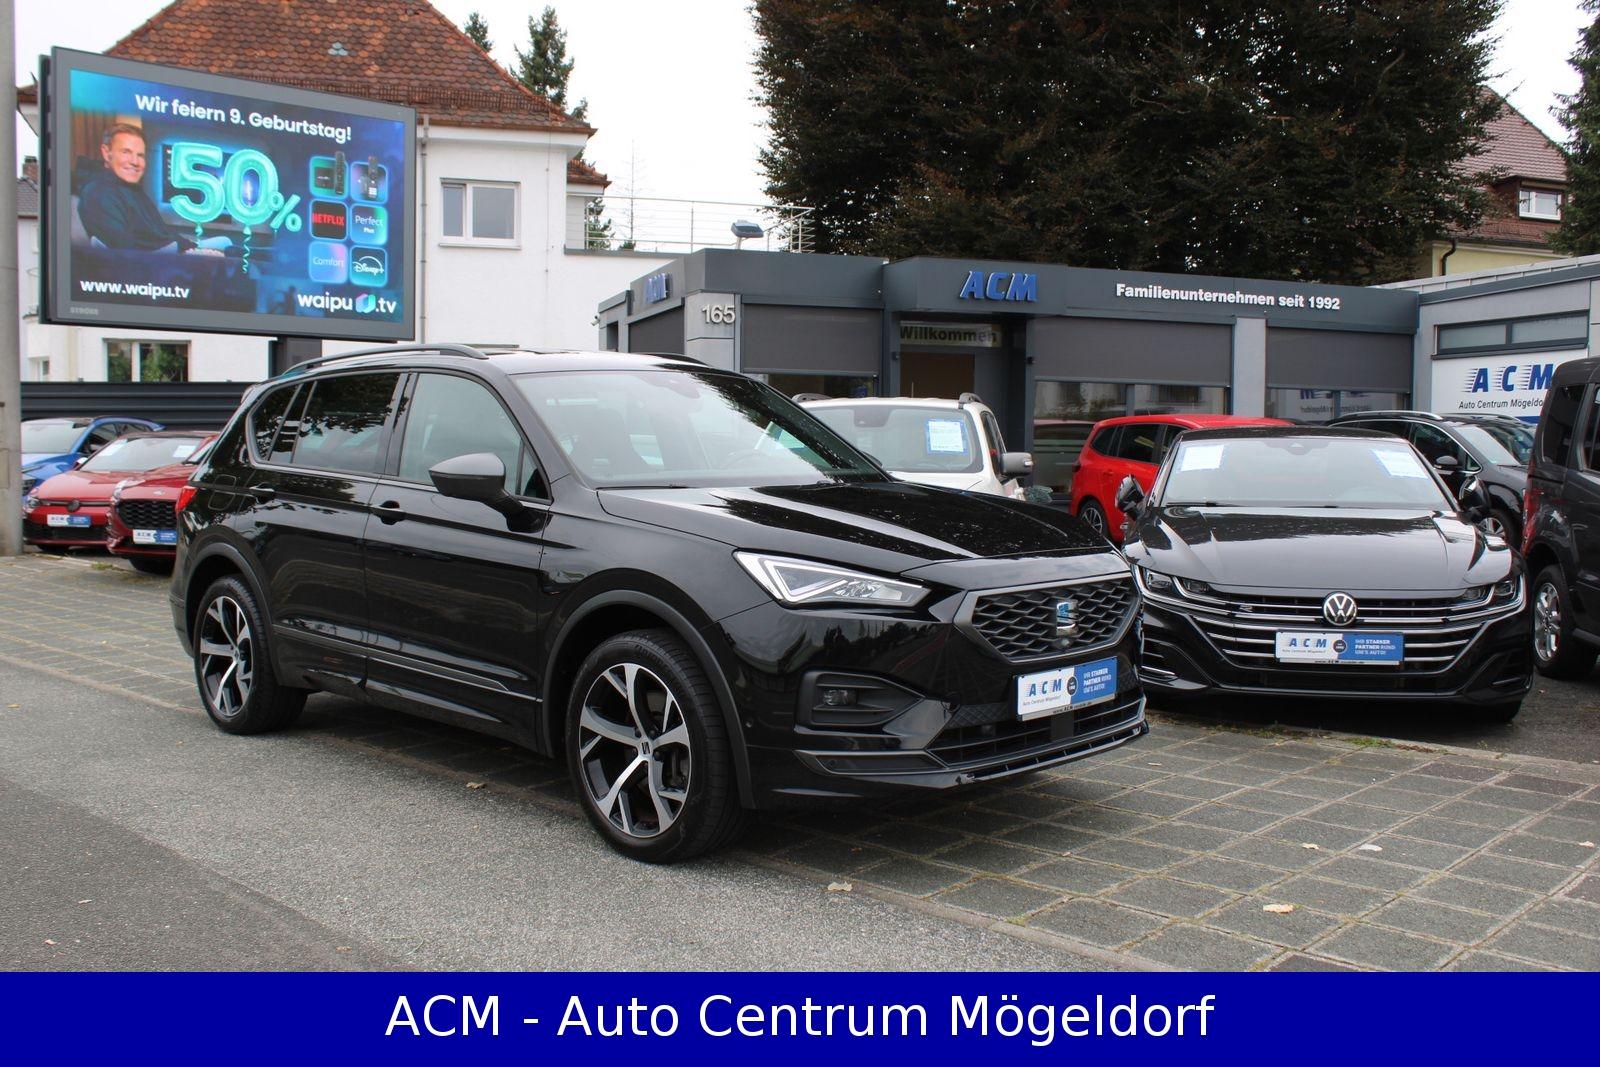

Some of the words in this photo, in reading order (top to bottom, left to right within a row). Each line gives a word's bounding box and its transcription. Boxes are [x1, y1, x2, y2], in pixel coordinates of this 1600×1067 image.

[135, 94, 168, 114] Wir
[171, 99, 225, 122] feiern
[230, 108, 246, 126] 9.
[249, 112, 352, 144] Geburtstag!
[170, 142, 302, 232] 50%
[312, 212, 345, 226] NETFLIX
[355, 215, 384, 226] Perfect
[312, 256, 344, 268] Comfort
[80, 280, 190, 300] www.waipu.tv
[959, 270, 1037, 301] ACM
[297, 291, 353, 313] waipu
[1116, 283, 1275, 306] Familienunternehmen
[1278, 294, 1305, 308] seit
[1308, 296, 1340, 310] 1992
[702, 304, 736, 324] 165
[900, 325, 997, 343] Willkommen
[1465, 363, 1554, 393] ACM
[1458, 401, 1475, 409] Auto
[1477, 399, 1508, 409] Centrum
[1510, 398, 1544, 410] Mögeldo
[1289, 638, 1327, 648] ACM
[1027, 678, 1062, 697] ACM
